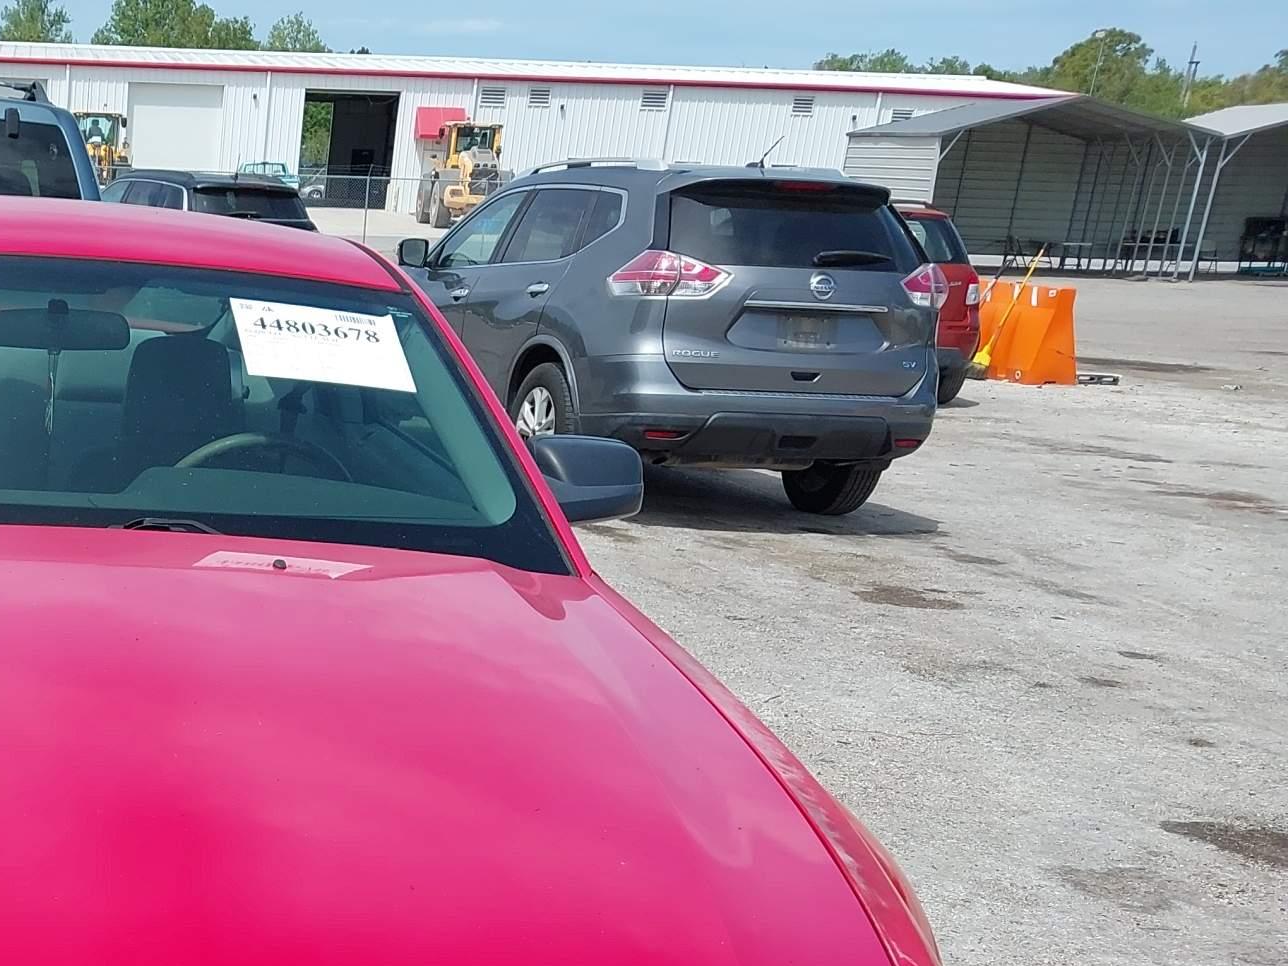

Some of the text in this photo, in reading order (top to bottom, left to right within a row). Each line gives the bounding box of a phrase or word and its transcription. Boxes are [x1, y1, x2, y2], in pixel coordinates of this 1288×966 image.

[253, 316, 380, 343] 44803678
[672, 349, 720, 358] ROGUE
[902, 360, 916, 368] SV
